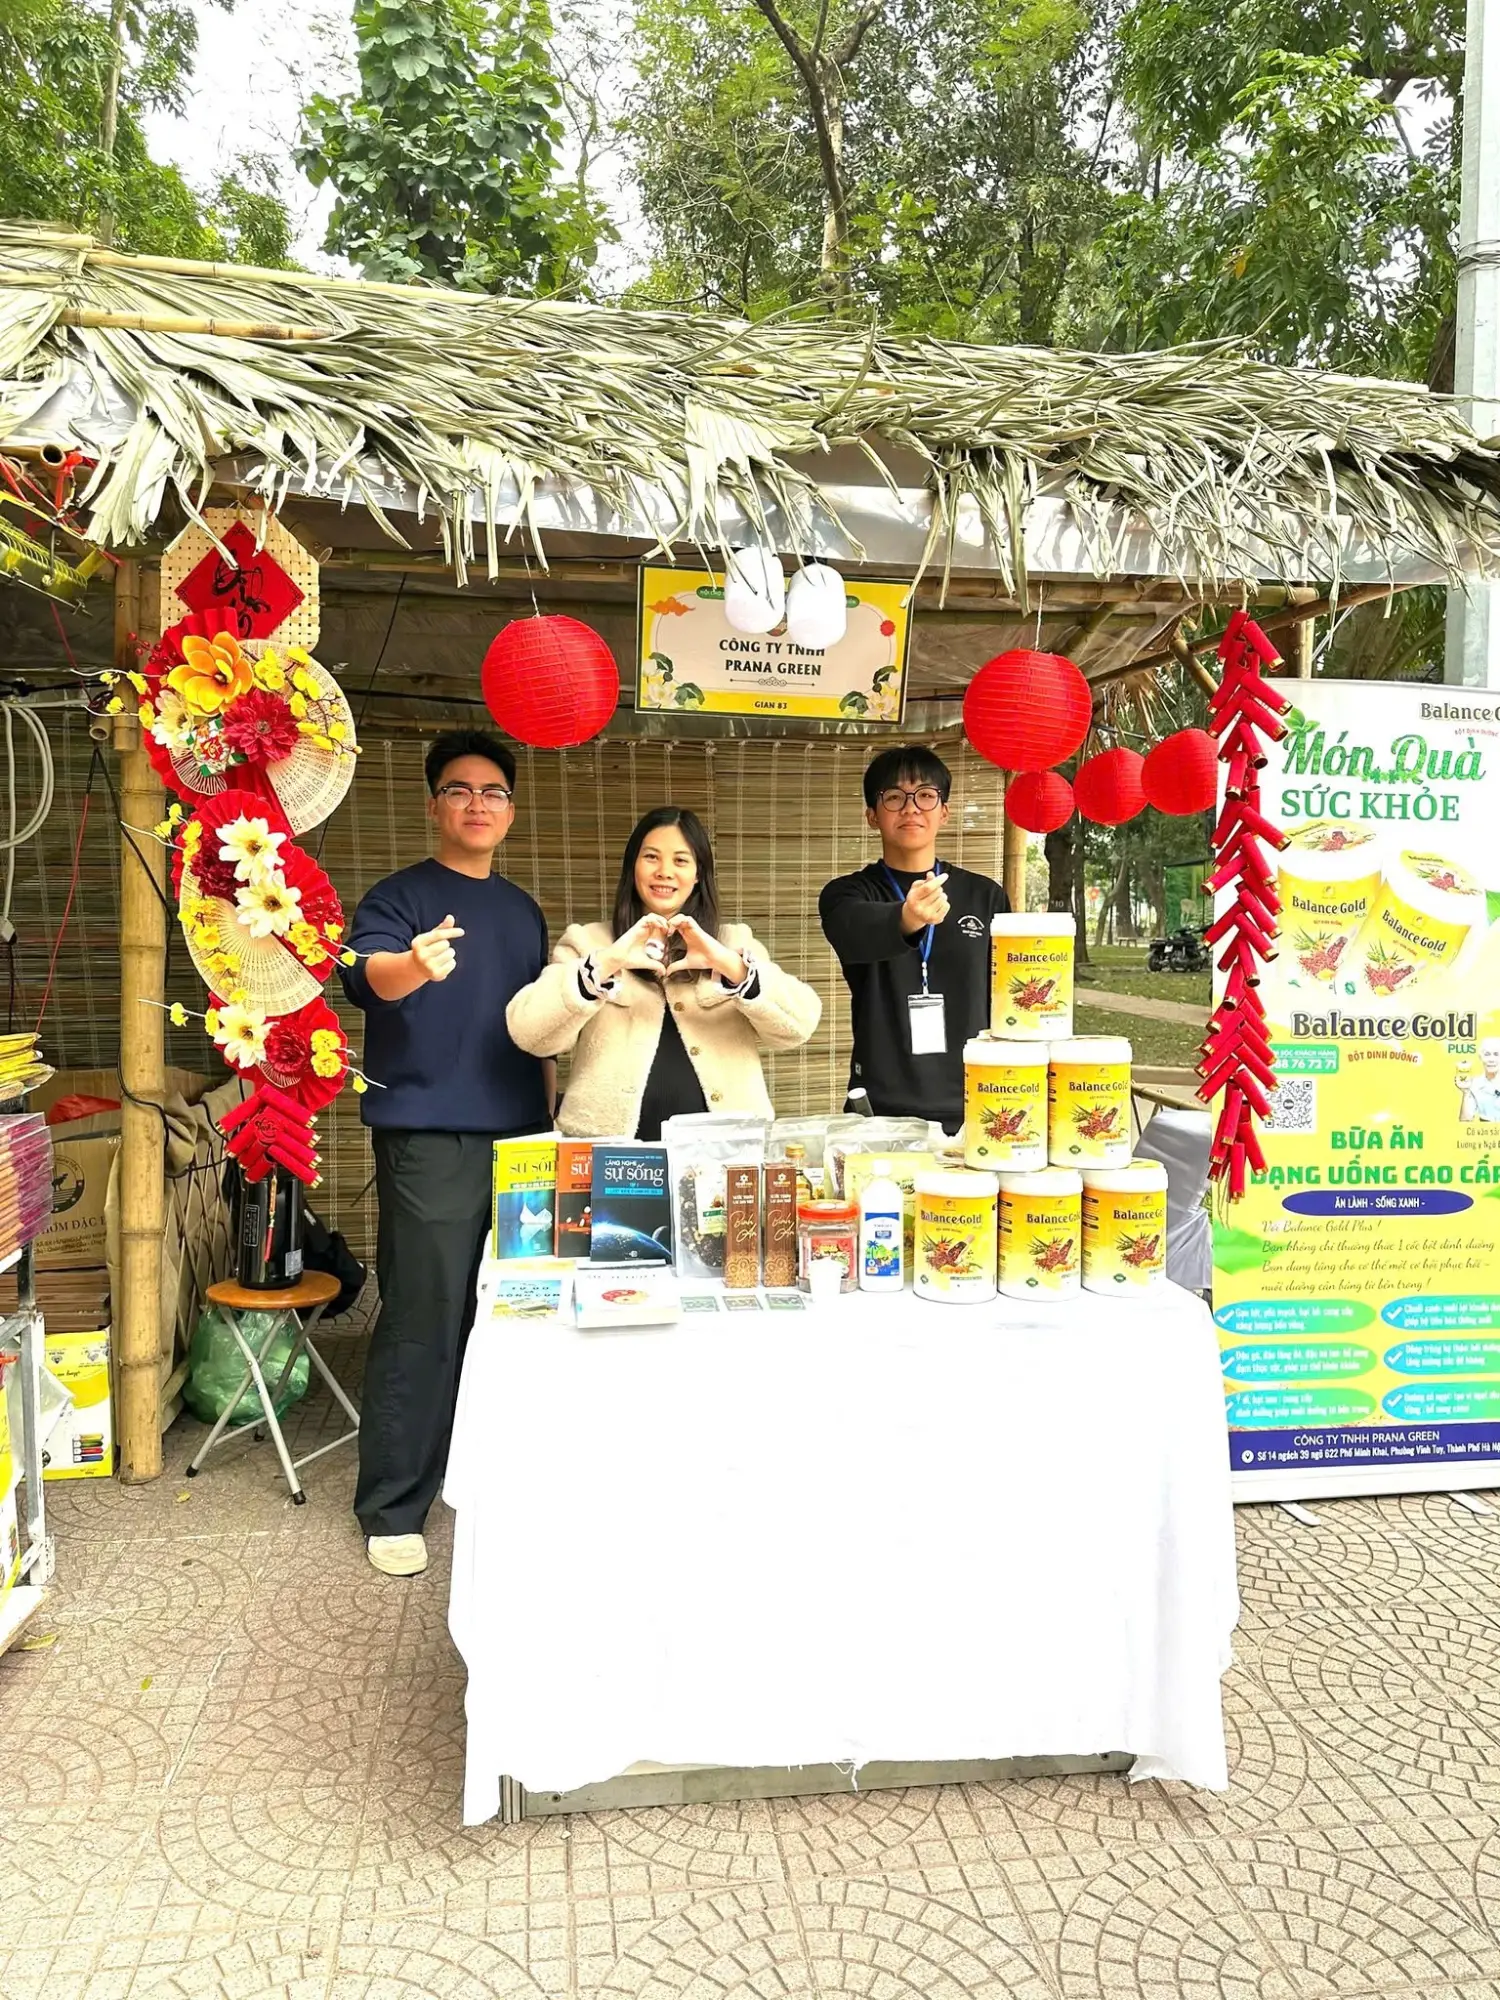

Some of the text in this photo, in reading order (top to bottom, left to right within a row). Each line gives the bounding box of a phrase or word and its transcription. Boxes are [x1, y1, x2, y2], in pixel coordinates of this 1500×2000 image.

[719, 638, 760, 652] CÔNG
[766, 642, 782, 654] TY
[725, 659, 822, 676] PRANA GREEN
[754, 700, 775, 709] GIAN
[1421, 702, 1491, 721] Balance
[1282, 730, 1486, 785] Món Quà
[1281, 783, 1460, 822] SỨC KHỎE
[1292, 895, 1367, 914] Balance Gold
[1382, 910, 1421, 944] Balance
[1420, 936, 1447, 953] Gold
[1007, 952, 1068, 962] Balance Gold
[1292, 1011, 1475, 1038] Balance Gold
[1447, 1043, 1477, 1055] PLUS
[1291, 1059, 1305, 1069] 76
[977, 1082, 1040, 1094] Balance Gold
[1069, 1081, 1111, 1092] Balance
[1331, 1125, 1424, 1149] BỮA ĂN
[571, 1161, 590, 1179] sự
[604, 1162, 664, 1188] sự sống
[1328, 1154, 1398, 1184] UỐNG
[1405, 1165, 1453, 1184] CAO
[1335, 1197, 1347, 1209] ĂN
[1375, 1196, 1397, 1208] SỐNG
[1398, 1197, 1420, 1208] XANH
[921, 1209, 983, 1225] Balance Gold
[1027, 1213, 1068, 1224] Balance
[1113, 1209, 1154, 1220] Balance
[71, 1215, 97, 1231] ĐẶC
[1326, 1220, 1348, 1232] Gold
[1352, 1219, 1373, 1232] Plus
[1262, 1240, 1283, 1254] Bạn
[1293, 1430, 1440, 1446] CÔNG TY TNHH PRANA GREEN
[1268, 1450, 1276, 1460] 14
[1300, 1450, 1309, 1459] 39
[1324, 1449, 1338, 1458] 622
